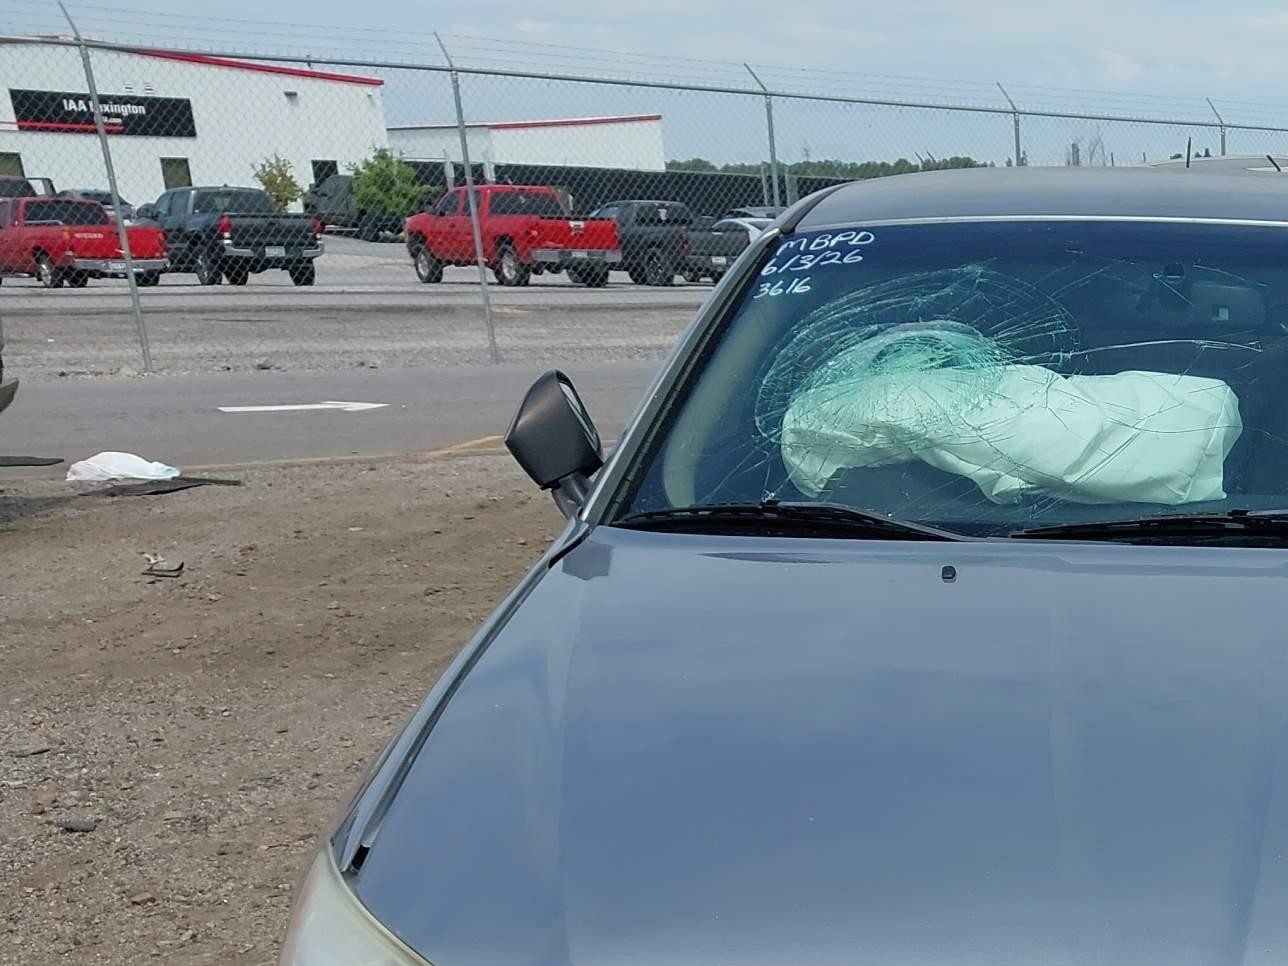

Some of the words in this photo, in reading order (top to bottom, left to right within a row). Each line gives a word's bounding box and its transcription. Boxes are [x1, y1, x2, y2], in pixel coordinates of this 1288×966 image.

[62, 99, 88, 112] IAA
[775, 231, 875, 256] MBPD
[761, 249, 864, 276] 6/3/26
[753, 277, 812, 299] 3616
